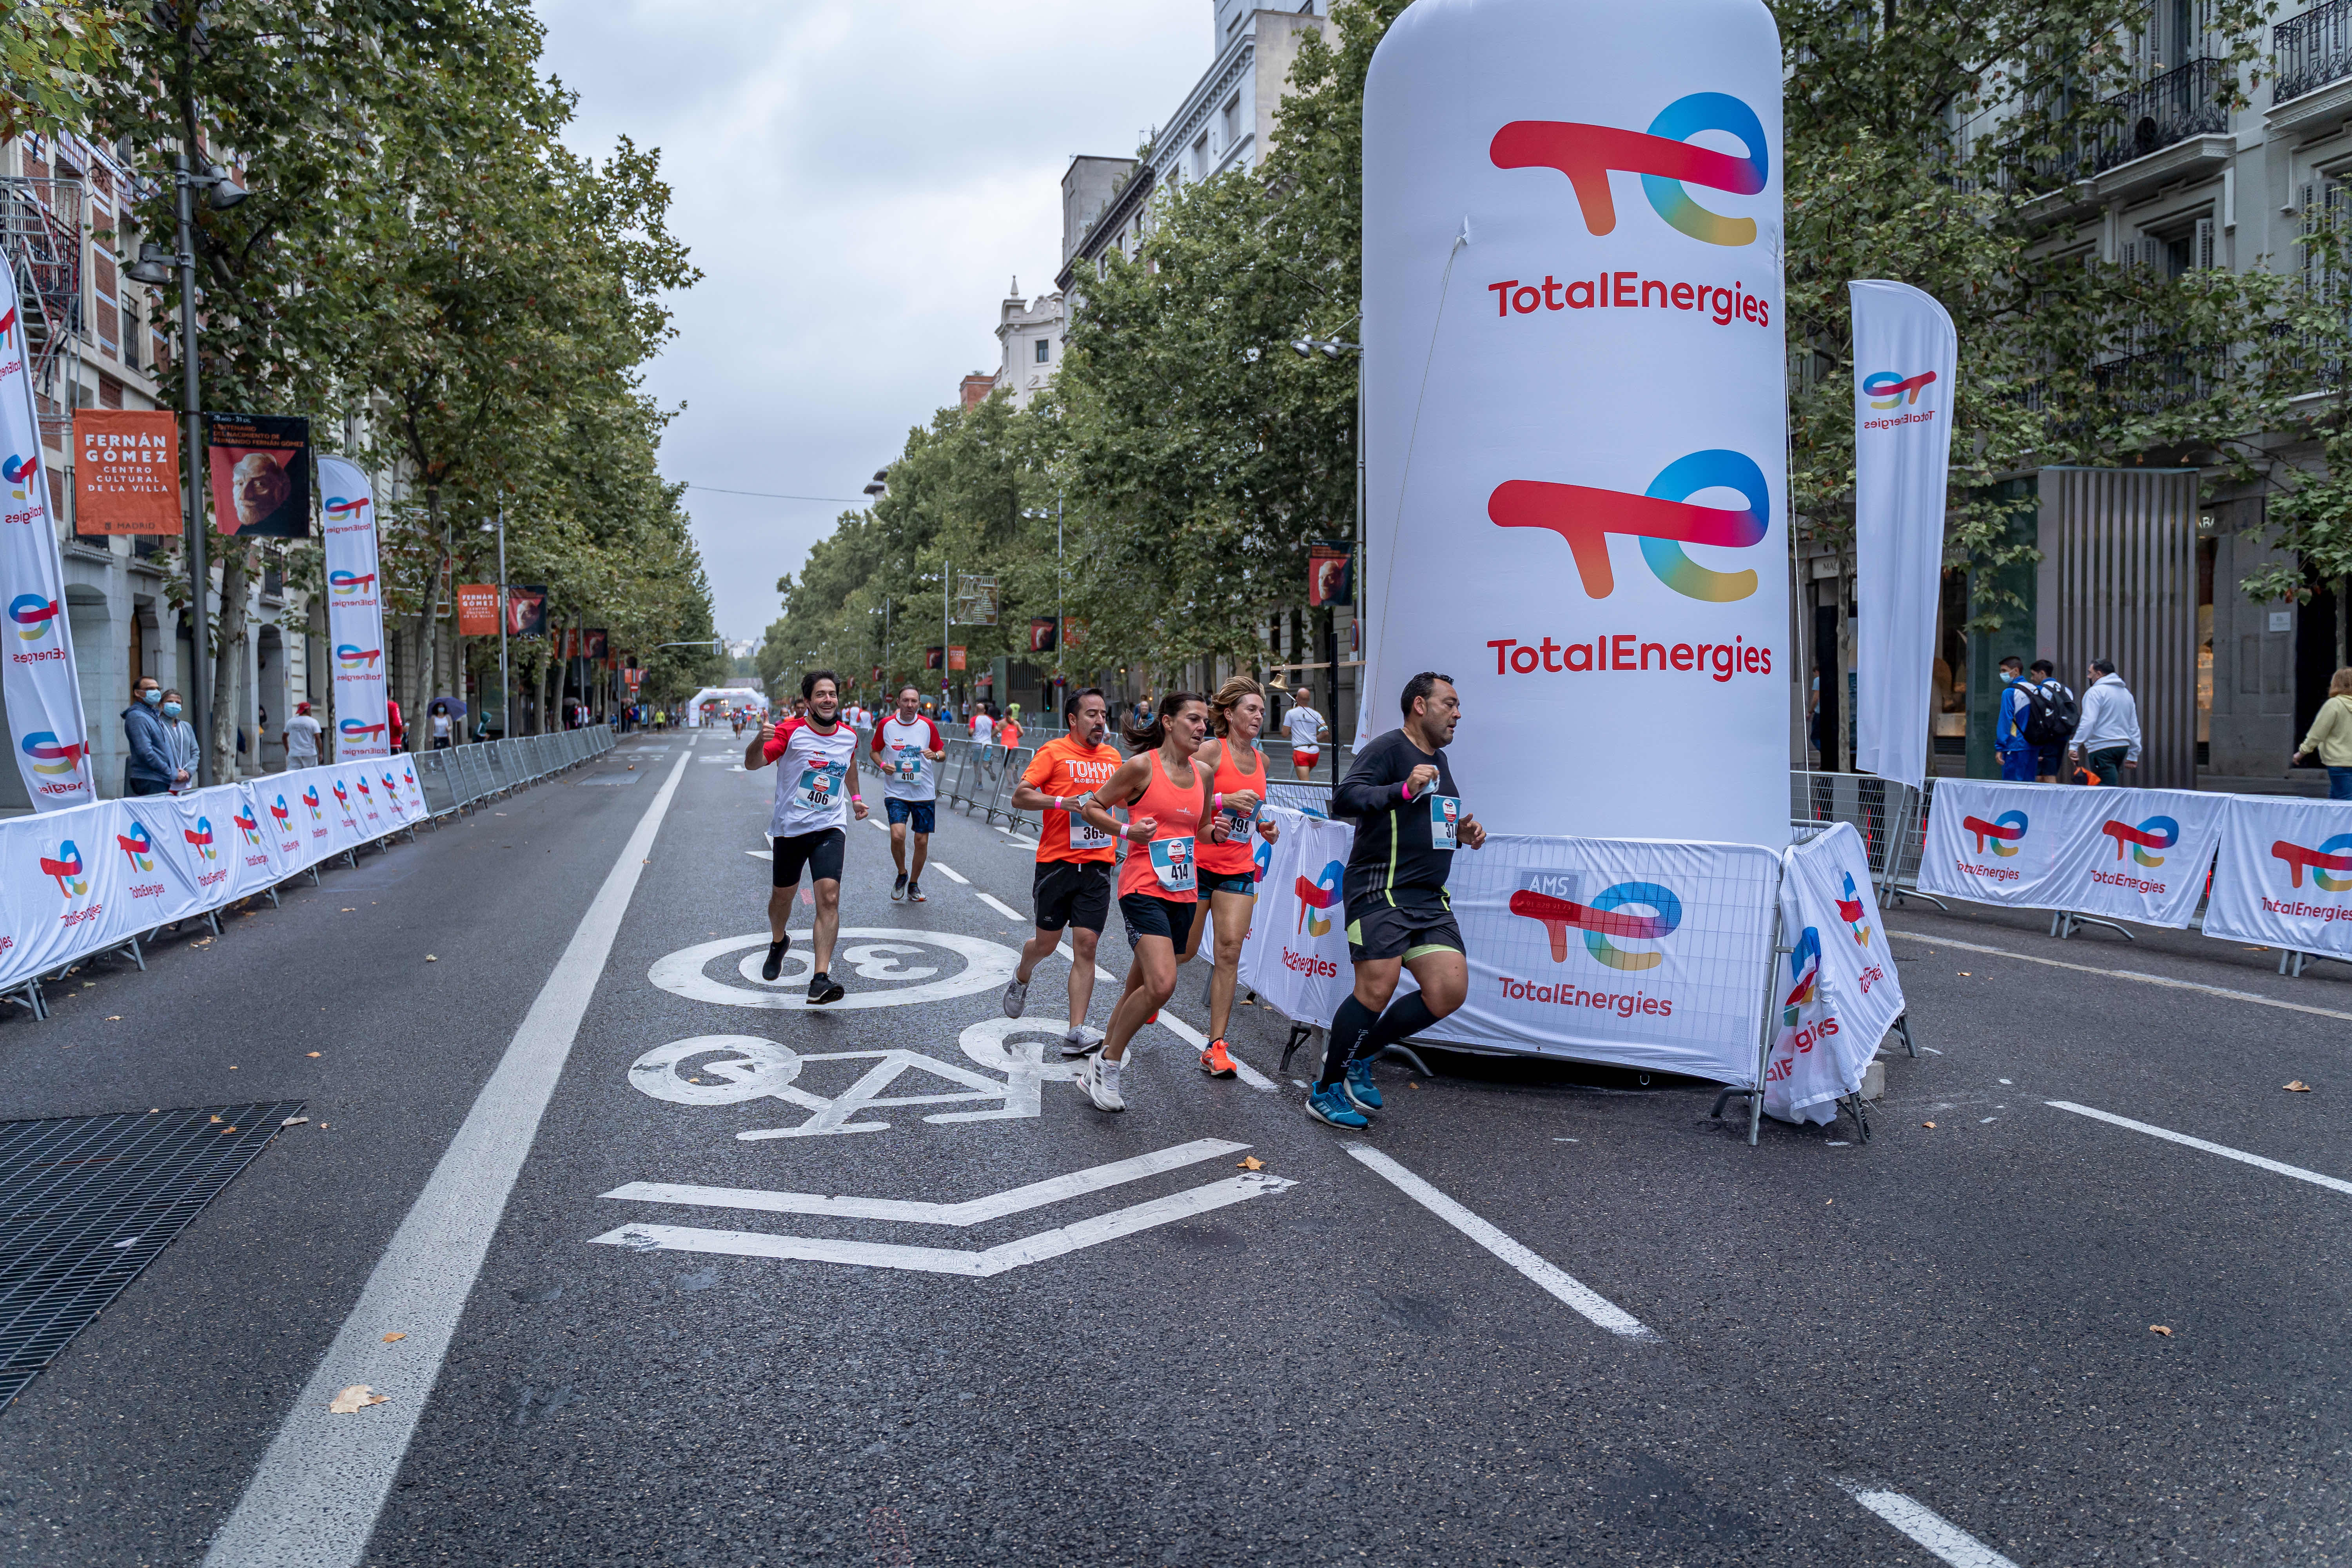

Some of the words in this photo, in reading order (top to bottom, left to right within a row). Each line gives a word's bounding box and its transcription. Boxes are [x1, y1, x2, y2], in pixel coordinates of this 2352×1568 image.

[1488, 271, 1769, 327] TotalEnergies
[85, 432, 166, 447] FERNÁN
[86, 447, 167, 463] GÓMEZ
[1487, 635, 1771, 682] TotalEnergies
[1065, 760, 1116, 779] TOKYO
[807, 790, 829, 805] 406
[1083, 826, 1105, 840] 369
[1230, 817, 1249, 834] 499
[1171, 864, 1188, 880] 414
[1529, 875, 1569, 897] AMS
[1499, 976, 1673, 1018] TotalEnergies
[1341, 1029, 1368, 1067] kalenji
